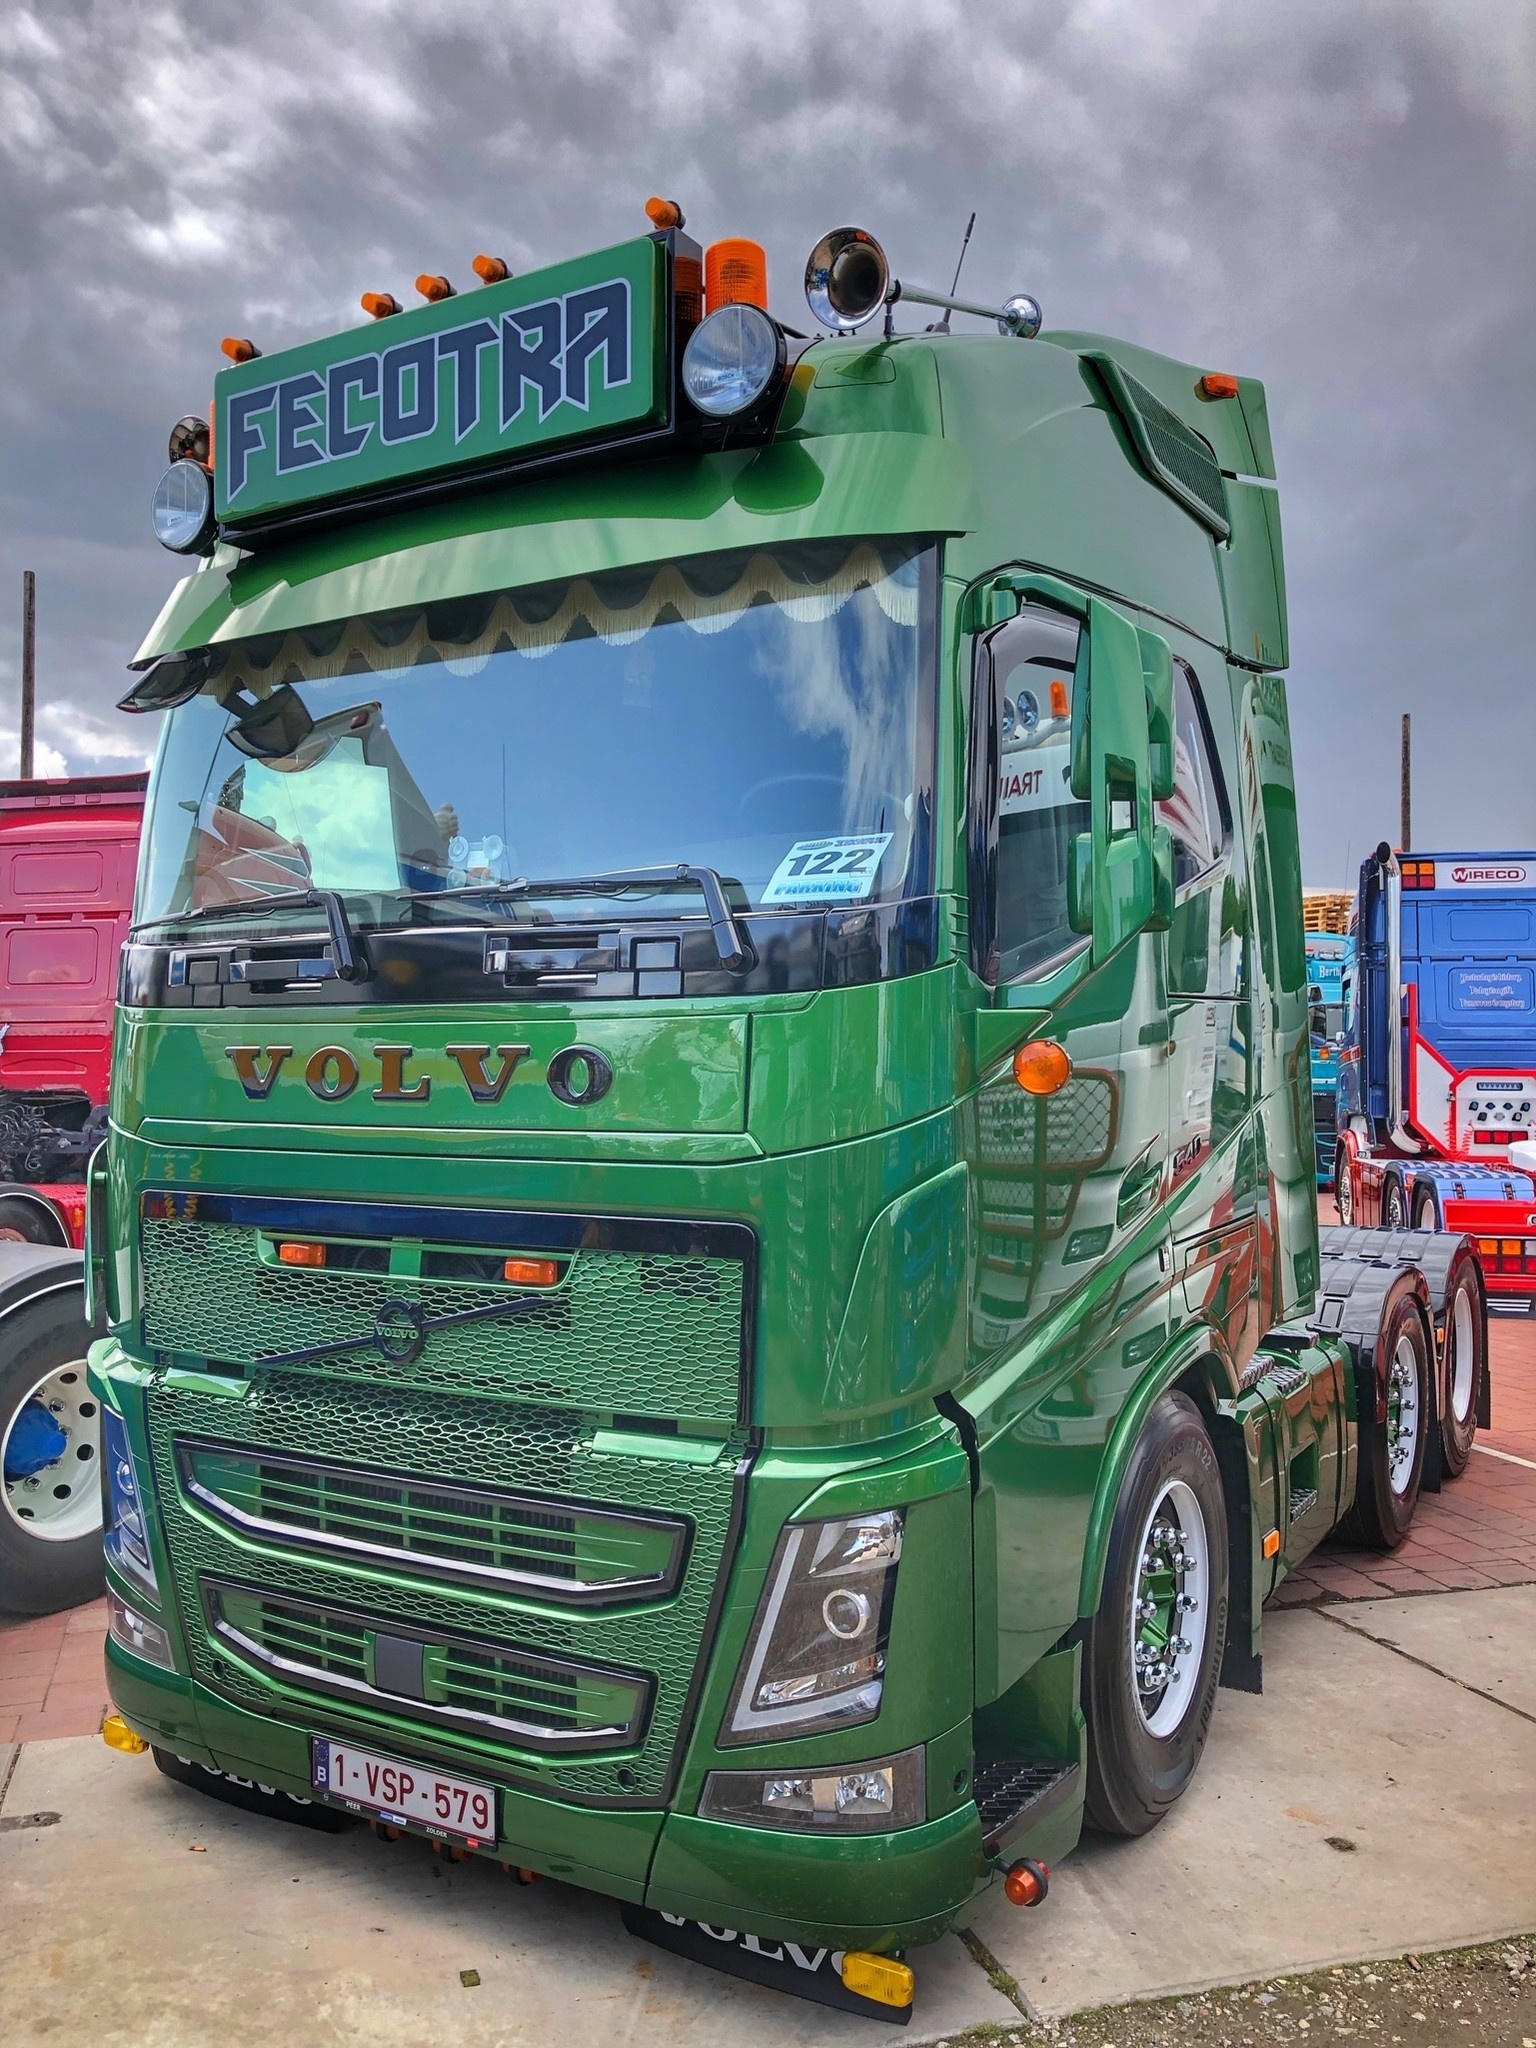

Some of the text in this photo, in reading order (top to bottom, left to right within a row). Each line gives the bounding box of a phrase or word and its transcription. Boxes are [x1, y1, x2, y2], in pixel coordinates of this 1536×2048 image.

[227, 277, 632, 504] FECOTRA
[787, 848, 876, 877] 122
[1452, 867, 1520, 882] WIRECO
[224, 1044, 613, 1107] VOLVO
[376, 1325, 419, 1339] VOLVO
[316, 1765, 327, 1783] B
[335, 1753, 489, 1830] 1-VSP-579
[345, 1800, 361, 1812] PEER
[425, 1826, 448, 1839] ZOLDER
